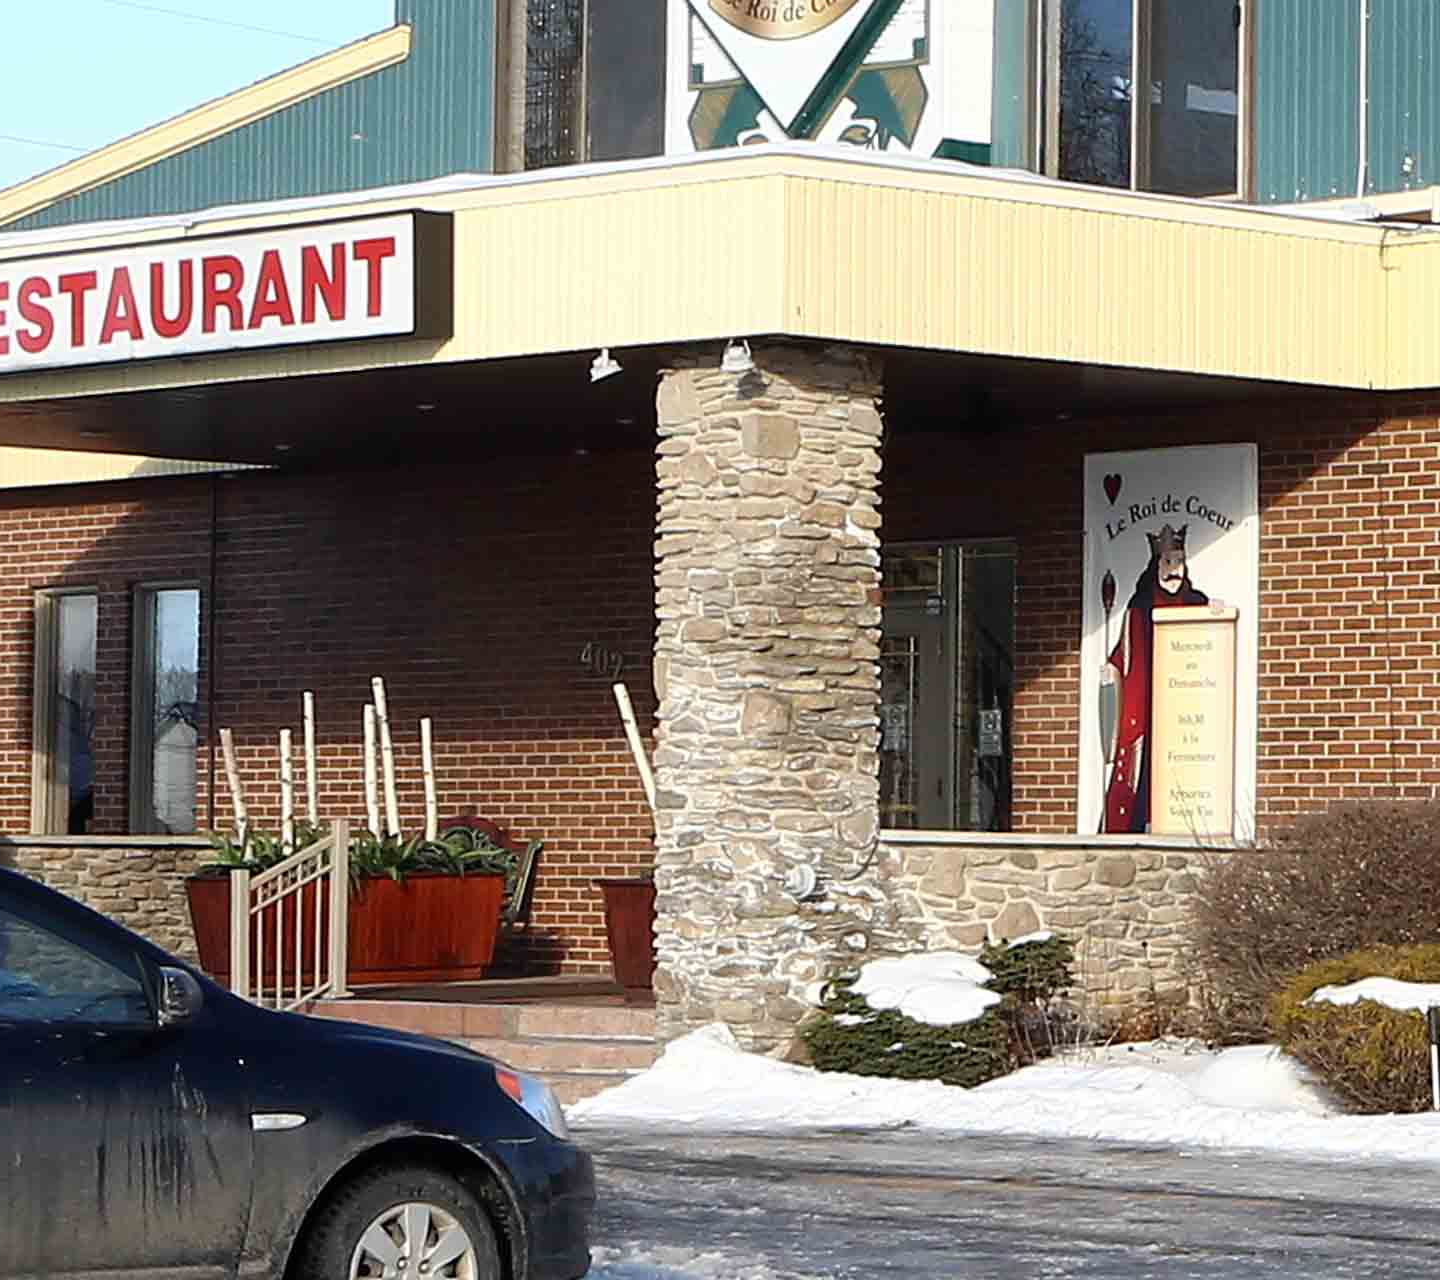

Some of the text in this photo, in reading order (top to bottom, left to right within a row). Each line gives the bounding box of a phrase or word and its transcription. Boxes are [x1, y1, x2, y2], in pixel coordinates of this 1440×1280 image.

[783, 0, 805, 21] de
[1105, 493, 1234, 540] Le Roi de Coeur
